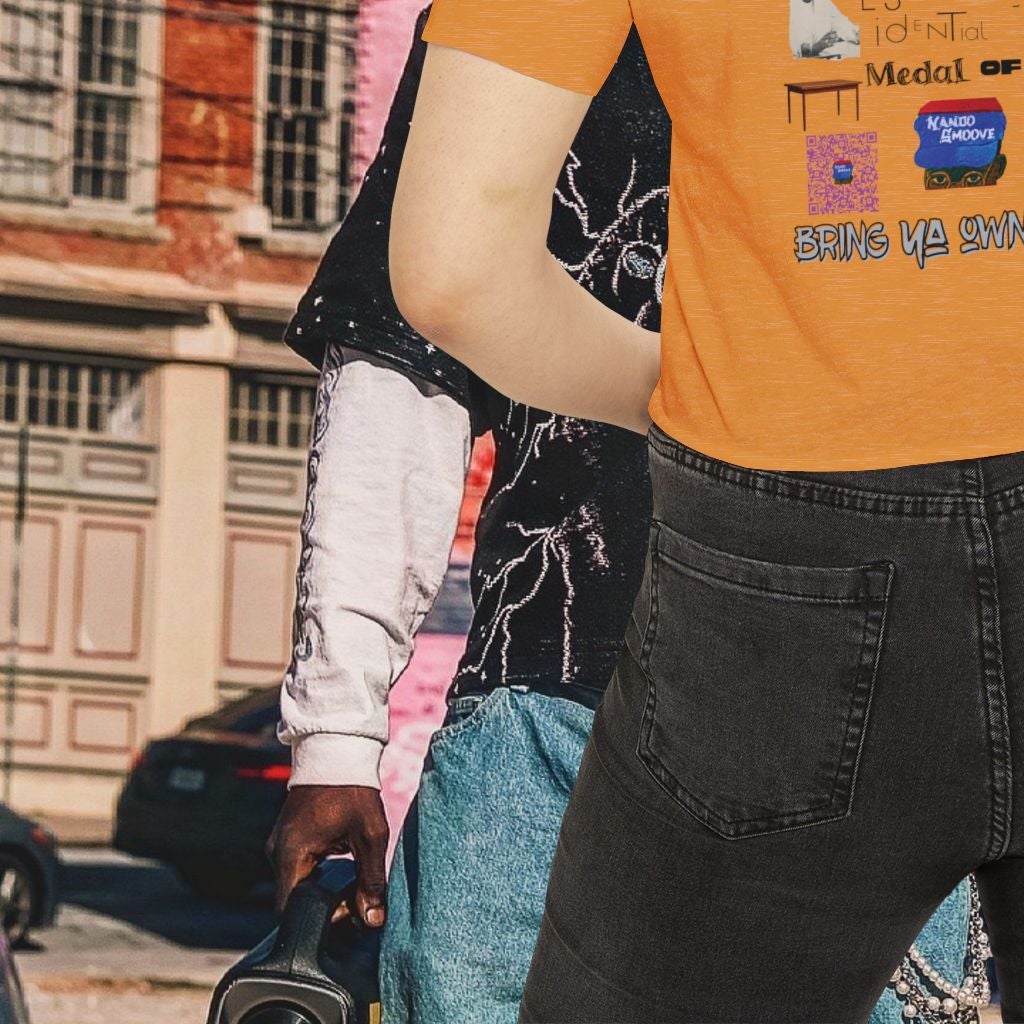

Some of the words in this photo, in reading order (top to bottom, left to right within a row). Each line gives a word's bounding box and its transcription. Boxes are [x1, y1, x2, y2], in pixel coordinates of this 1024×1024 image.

[864, 58, 971, 87] Medal
[980, 59, 1021, 77] OF
[940, 127, 995, 144] SMOOVE
[794, 220, 889, 263] BRING
[900, 218, 949, 269] YA
